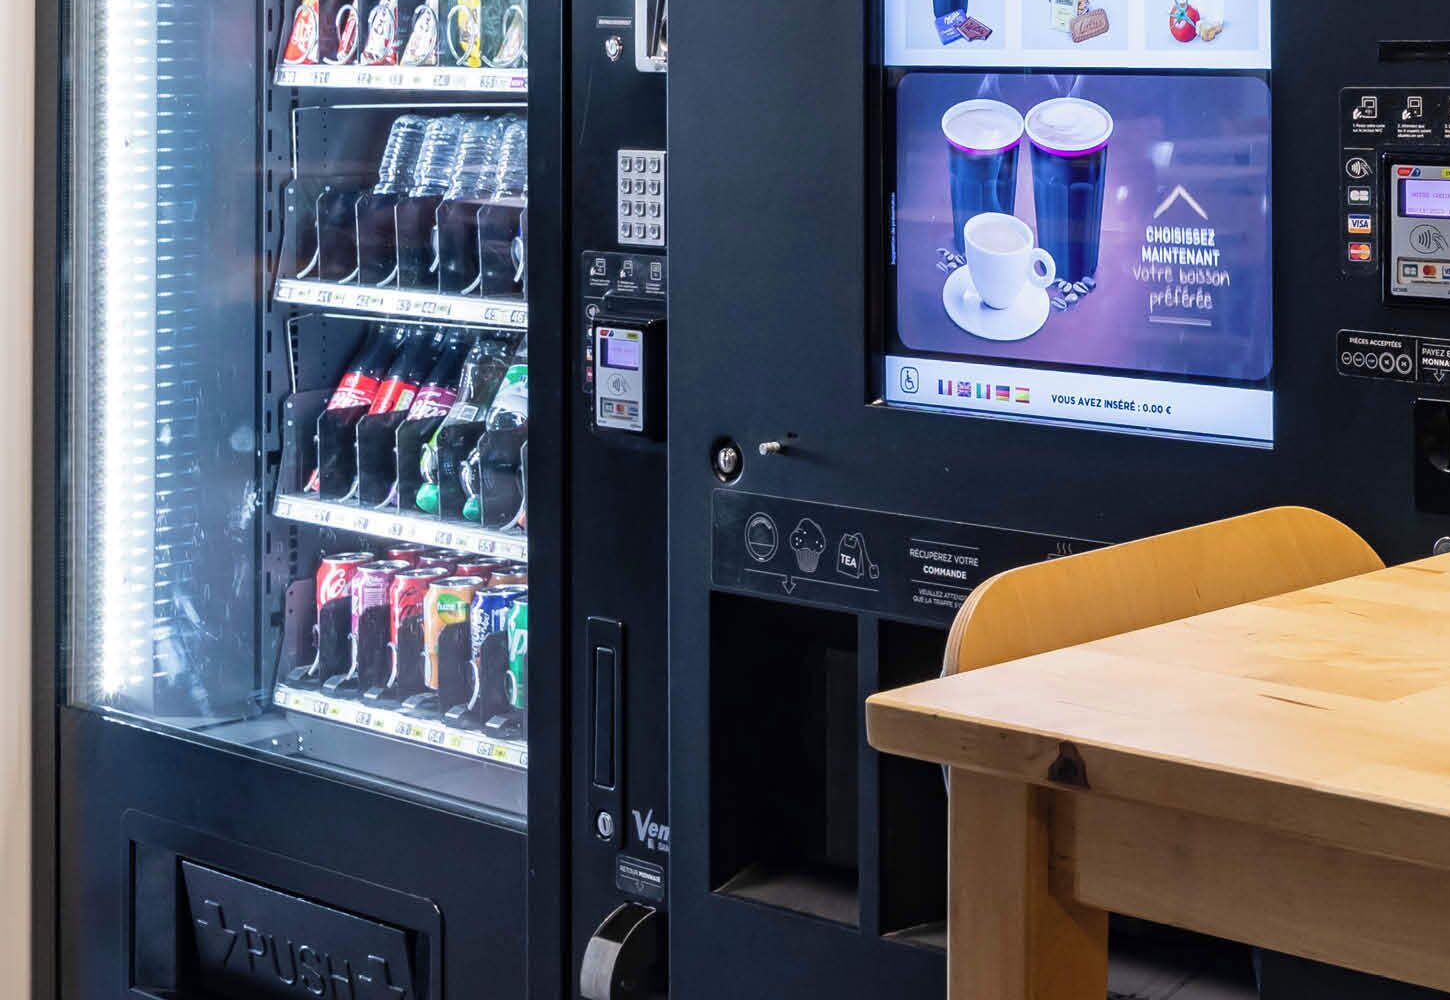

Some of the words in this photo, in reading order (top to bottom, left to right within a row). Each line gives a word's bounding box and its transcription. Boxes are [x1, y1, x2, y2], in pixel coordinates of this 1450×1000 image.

[1351, 220, 1369, 229] VISA
[1145, 226, 1216, 246] CHOISISSEZ
[1141, 246, 1220, 267] MAINTENANT
[1133, 266, 1172, 283] votre
[1179, 267, 1231, 287] boisson
[1149, 285, 1213, 313] préférée
[1422, 348, 1444, 357] PAYEZ
[1051, 394, 1075, 405] VOUS
[1077, 396, 1102, 408] AVEZ
[1104, 397, 1136, 412] INSÉRÉ
[1142, 402, 1164, 414] 0.00
[1165, 404, 1172, 414] €
[840, 553, 857, 569] TEA
[909, 546, 952, 564] RÉCUPÉREZ
[953, 554, 979, 567] VOTRE
[923, 565, 967, 580] COMMANDE
